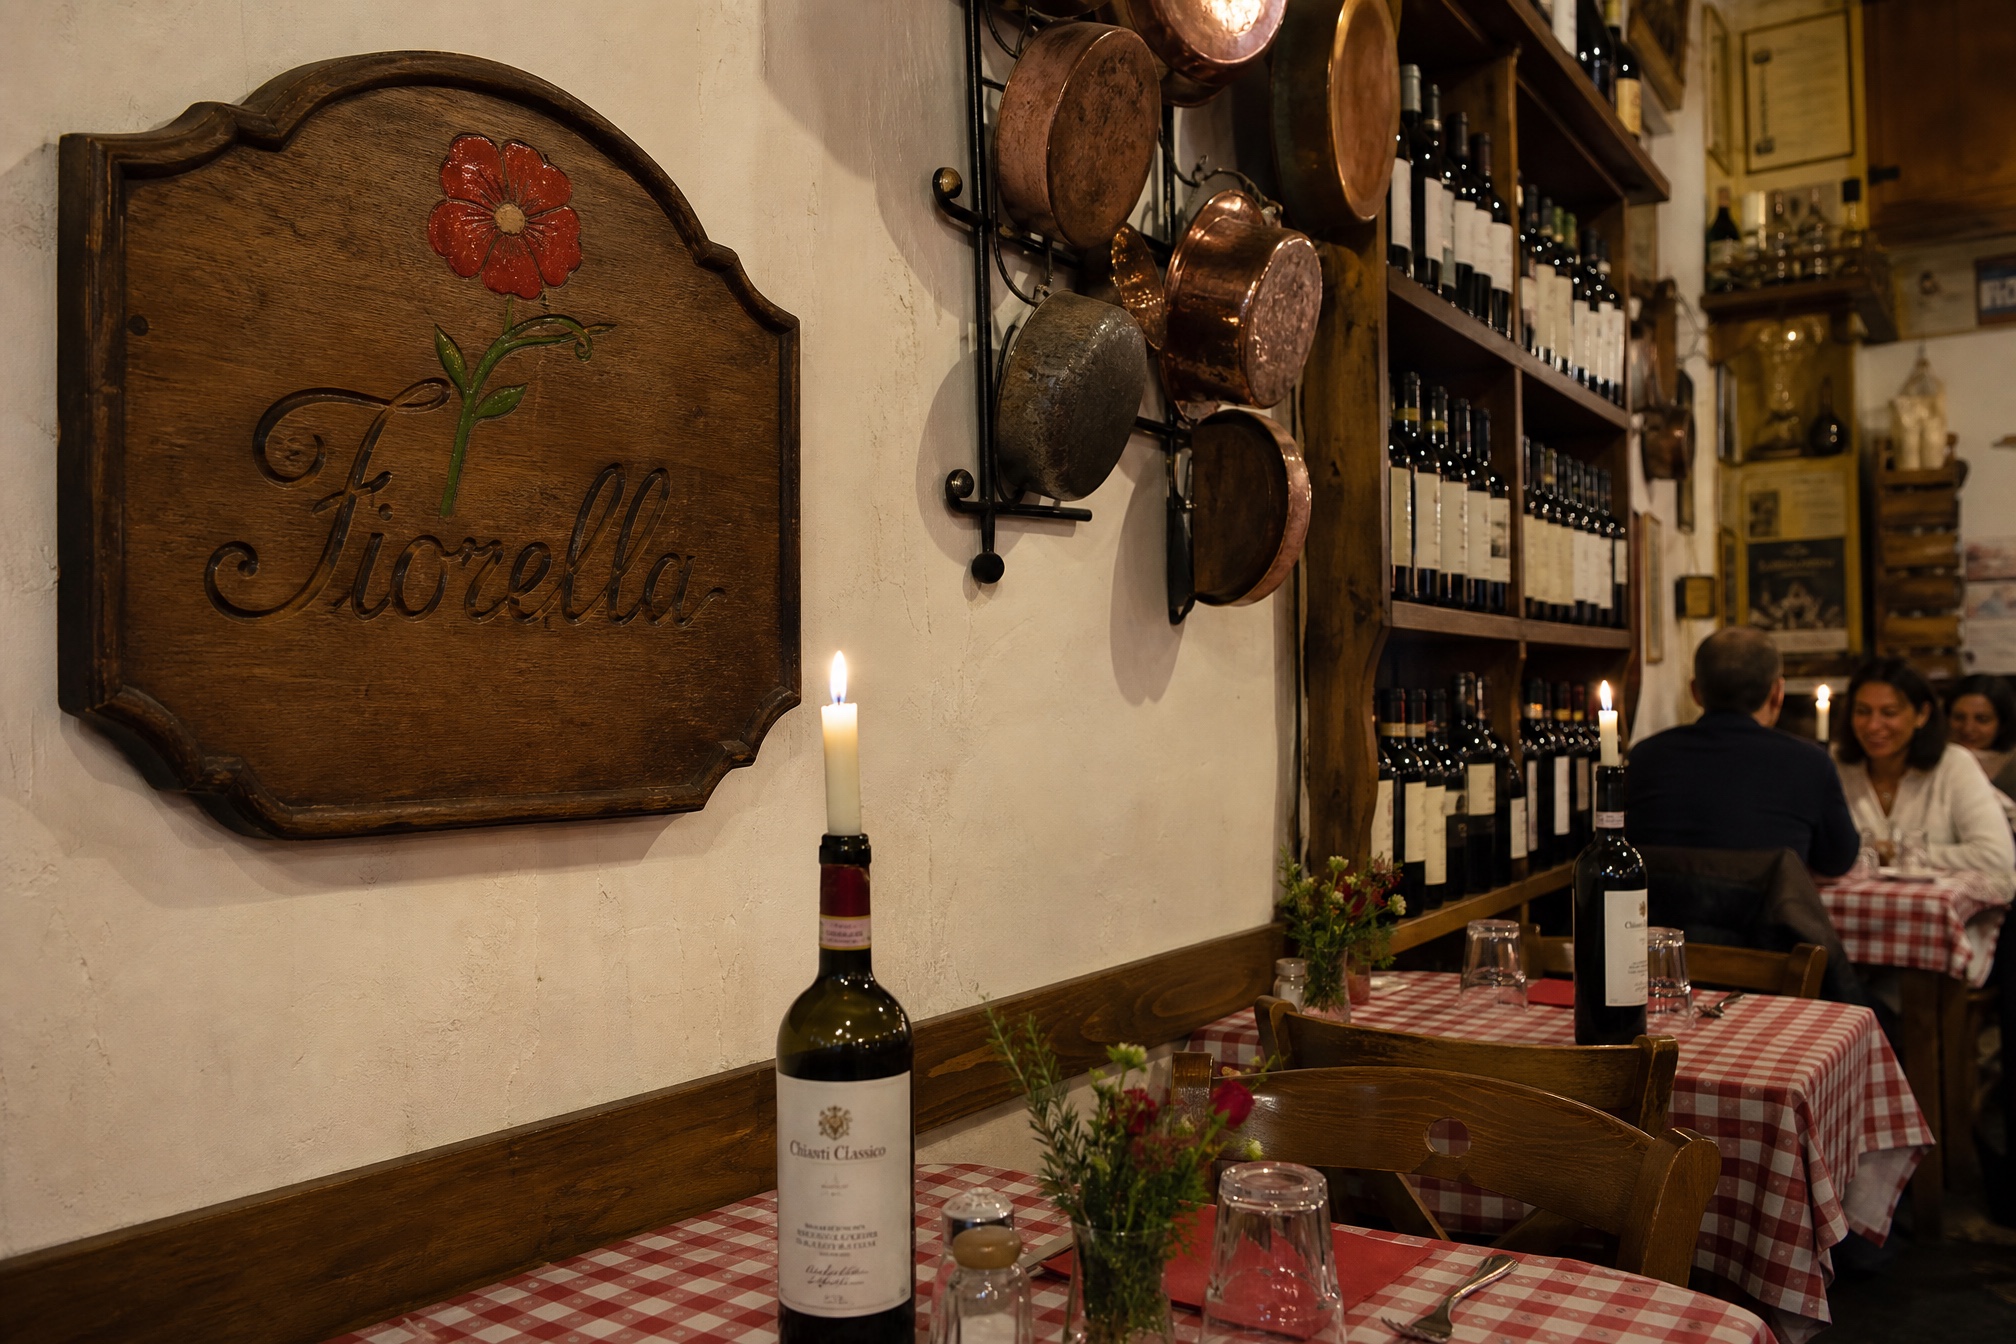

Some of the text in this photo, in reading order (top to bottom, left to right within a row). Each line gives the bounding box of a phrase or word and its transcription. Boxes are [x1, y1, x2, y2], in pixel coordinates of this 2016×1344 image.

[204, 377, 727, 628] Fiorella
[789, 1139, 887, 1161] Chianti Classico
